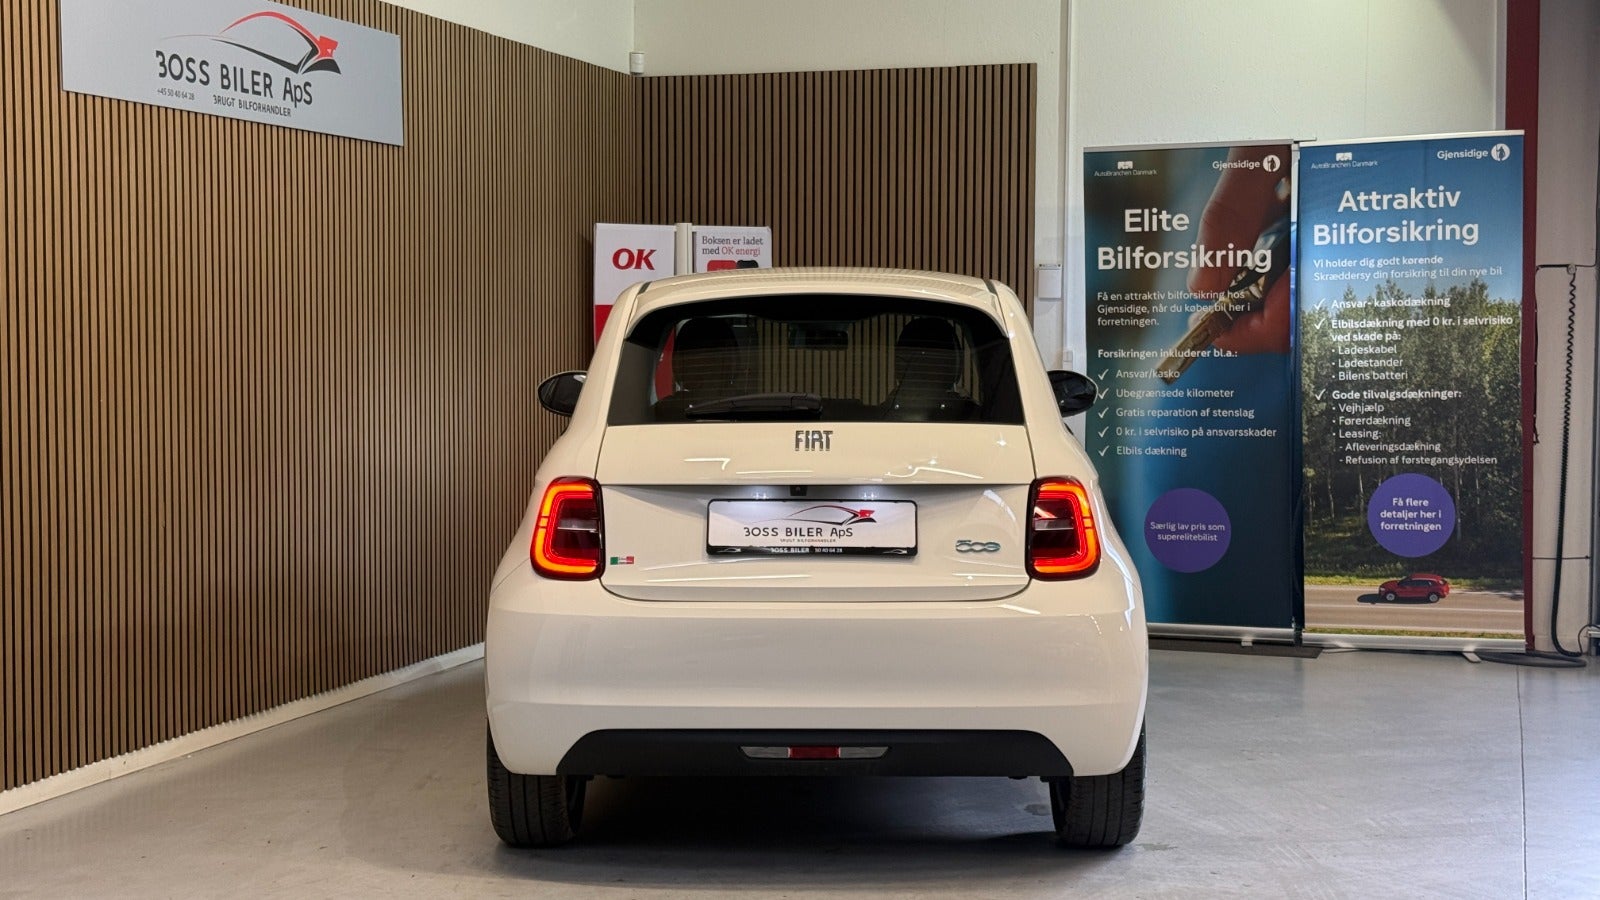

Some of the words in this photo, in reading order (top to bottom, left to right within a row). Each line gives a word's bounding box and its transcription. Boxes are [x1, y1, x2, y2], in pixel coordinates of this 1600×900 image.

[220, 64, 273, 98] BILER
[282, 77, 313, 108] ApS
[167, 88, 174, 97] 50
[174, 89, 181, 98] 40
[238, 99, 292, 117] BILFORHANDLER
[1437, 148, 1488, 160] Gjensidige
[1212, 160, 1260, 171] Gjensidige
[1338, 185, 1461, 212] Attraktiv
[1124, 208, 1190, 232] Elite
[1314, 218, 1479, 245] Bilforsikring
[702, 236, 731, 245] Boksen
[743, 236, 763, 245] ladet
[702, 246, 720, 255] med
[721, 247, 734, 255] OK
[735, 247, 761, 257] energi
[612, 248, 657, 270] OK
[1098, 243, 1272, 273] Bilforsikring
[1314, 259, 1324, 268] Vi
[1326, 258, 1357, 267] holder
[1360, 258, 1375, 268] dig
[1377, 257, 1400, 268] godt
[1402, 256, 1443, 265] kørende
[1314, 271, 1370, 282] Skræddersy
[1373, 270, 1388, 279] din
[1391, 269, 1436, 280] forsikring
[1439, 268, 1449, 277] til
[1452, 268, 1467, 277] din
[1470, 269, 1488, 278] nye
[1490, 266, 1502, 276] bil
[1098, 291, 1108, 301] Få
[1124, 292, 1165, 300] attraktiv
[1167, 290, 1224, 301] bilforsikring
[1227, 290, 1245, 299] hos
[1331, 299, 1372, 309] Ansvar-
[1374, 297, 1451, 308] kaskodækning
[1098, 304, 1150, 316] Gjensidige,
[1152, 302, 1168, 313] når
[1170, 304, 1182, 313] du
[1184, 304, 1212, 312] køber
[1214, 303, 1226, 312] bil
[1228, 303, 1244, 312] her
[1098, 317, 1159, 328] forretningen.
[1331, 319, 1404, 329] Elbilsdækning
[1406, 318, 1430, 327] med
[1432, 317, 1440, 326] 0
[1442, 317, 1455, 326] kr.
[1463, 316, 1513, 325] selvrisiko
[1332, 332, 1351, 342] ved
[1353, 332, 1383, 341] skade
[1385, 332, 1401, 343] på:
[1098, 349, 1158, 360] Forsikringen
[1160, 349, 1211, 358] inkluderer
[1213, 349, 1238, 358] bl.a.:
[1338, 345, 1397, 354] Ladeskabel
[1338, 358, 1404, 368] Ladestander
[1116, 369, 1180, 378] Ansvar/kasko
[1338, 371, 1370, 381] Bilens
[1373, 371, 1408, 380] batteri
[1116, 389, 1184, 400] Ubegrænsede
[1186, 389, 1234, 398] kilometer
[1332, 390, 1360, 400] Gode
[1363, 389, 1462, 401] tilvalgsdækninger:
[1116, 408, 1145, 417] Gratis
[1147, 408, 1198, 418] reparation
[1200, 408, 1210, 417] af
[1212, 408, 1255, 419] stenslag
[1339, 403, 1384, 413] Vejhjælp
[1339, 416, 1411, 427] Førerdækning
[1116, 428, 1122, 436] 0
[1124, 428, 1137, 436] kr.
[1144, 428, 1189, 436] selvrisiko
[1192, 427, 1203, 438] på
[1206, 428, 1277, 437] ansvarsskader
[1339, 429, 1382, 440] Leasing:
[795, 430, 833, 451] FIAT
[1116, 446, 1142, 455] Elbils
[1145, 446, 1187, 457] dækning
[1345, 442, 1441, 453] Afleveringsdækning
[1345, 456, 1387, 464] Refusion
[1390, 456, 1400, 464] af
[1401, 455, 1498, 466] førstegangsydelsen
[1392, 498, 1404, 507] Få
[1406, 498, 1429, 507] flere
[1380, 510, 1417, 520] detaljer
[1420, 510, 1436, 519] her
[1150, 522, 1175, 532] Særlig
[1178, 522, 1189, 530] lav
[1191, 522, 1206, 532] pris
[1380, 522, 1442, 532] forretningen
[785, 527, 823, 537] BILER
[830, 527, 853, 539] ApS
[1158, 533, 1218, 543] superelitebilist
